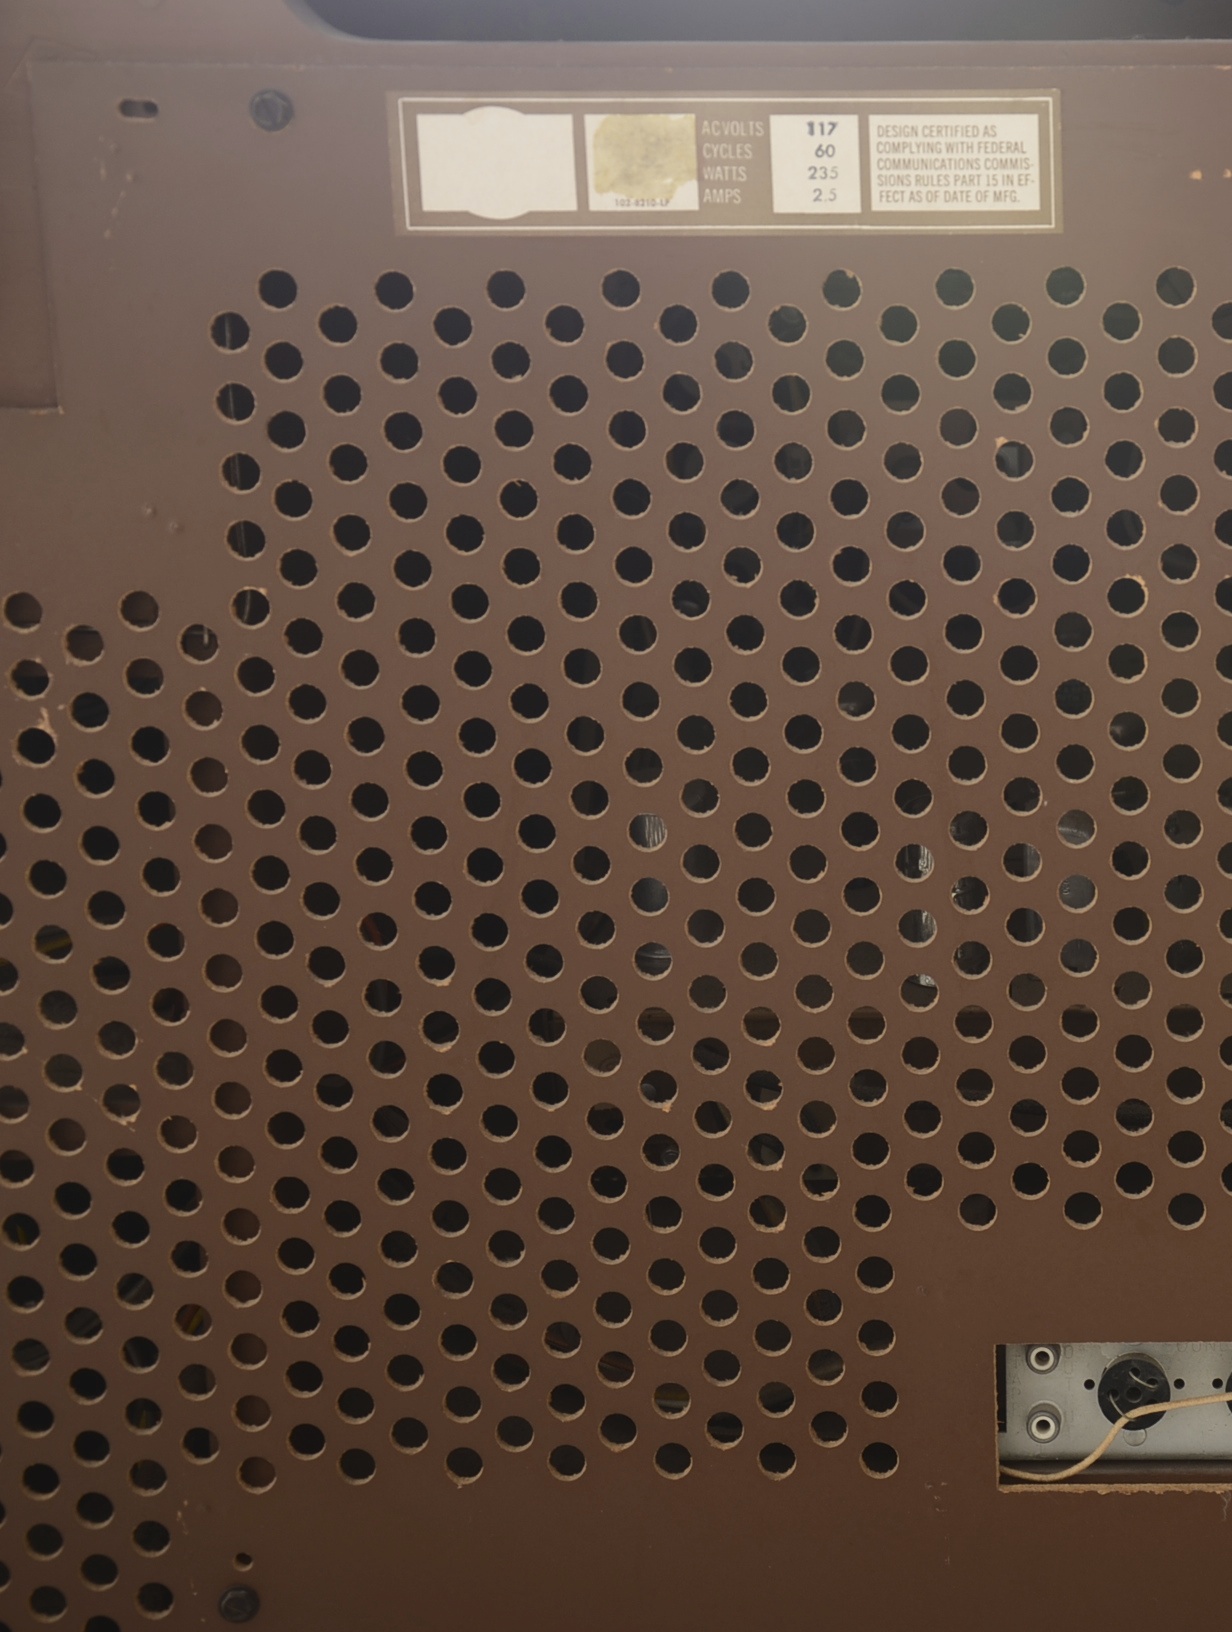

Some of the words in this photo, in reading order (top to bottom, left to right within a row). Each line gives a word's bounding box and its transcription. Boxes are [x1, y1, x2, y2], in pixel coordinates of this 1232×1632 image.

[807, 120, 839, 137] 117
[877, 124, 919, 138] DESIGN
[922, 124, 980, 138] CERTIFIED
[983, 124, 997, 138] AS
[703, 143, 753, 159] CYCLES
[815, 143, 836, 158] 60
[876, 140, 942, 154] COMPLYING
[945, 140, 974, 154] WITH
[977, 140, 1027, 154] FEDERAL
[876, 157, 982, 171] COMMUNICATIONS
[984, 157, 1034, 171] COMMIS-
[703, 165, 748, 182] WATTS
[807, 165, 839, 180] 235
[877, 173, 912, 187] SIONS
[915, 173, 951, 187] RULES
[953, 173, 982, 187] PART
[986, 173, 999, 187] 15
[1001, 173, 1015, 187] IN
[1017, 173, 1035, 187] EF-
[703, 189, 742, 204] AMPS
[813, 188, 837, 203] 2.5
[879, 189, 905, 203] FECT
[908, 189, 923, 203] AS
[925, 189, 940, 203] OF
[943, 189, 972, 203] DATE
[974, 189, 990, 203] OF
[992, 189, 1020, 203] MFG.
